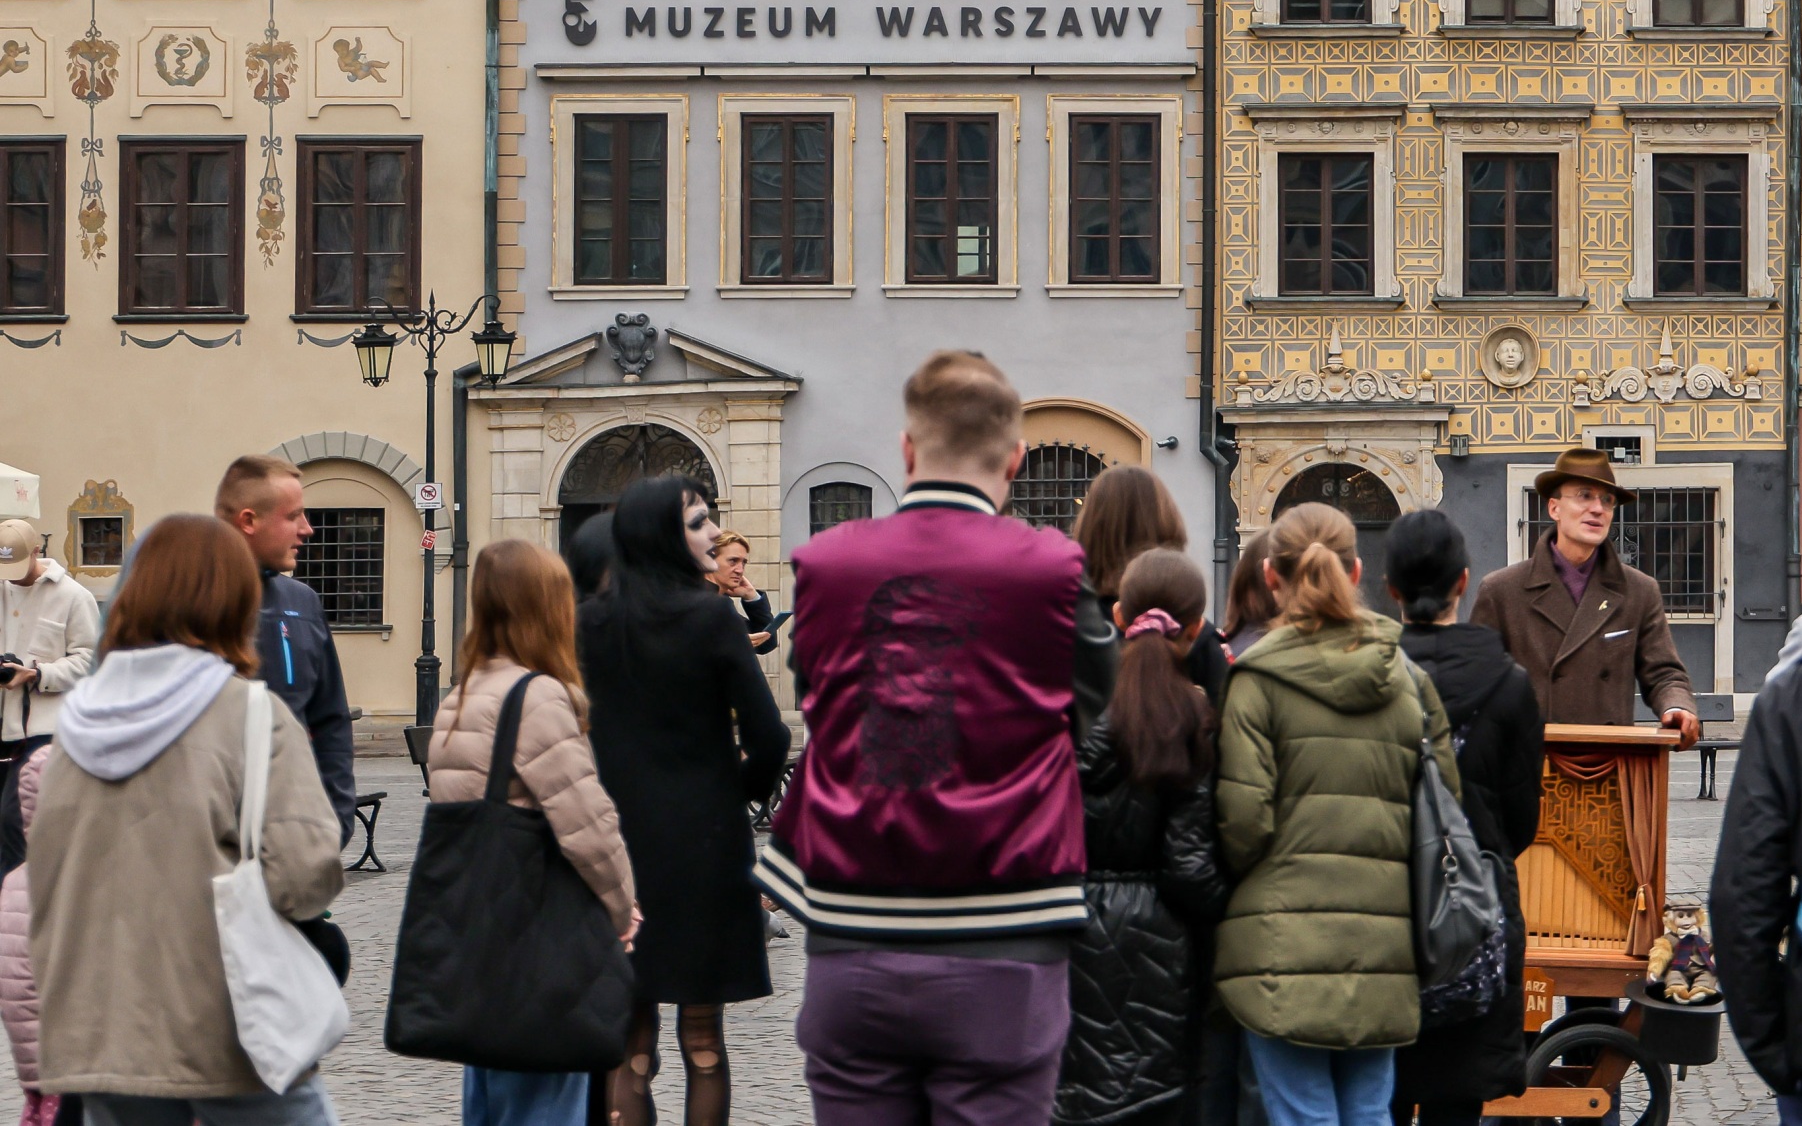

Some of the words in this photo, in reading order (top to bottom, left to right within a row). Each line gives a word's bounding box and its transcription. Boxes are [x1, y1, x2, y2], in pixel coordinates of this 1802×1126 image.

[625, 6, 836, 38] MUZEUM
[876, 5, 1164, 38] WARSZAWY
[1525, 980, 1547, 993] ARZ
[1526, 994, 1547, 1012] AN
